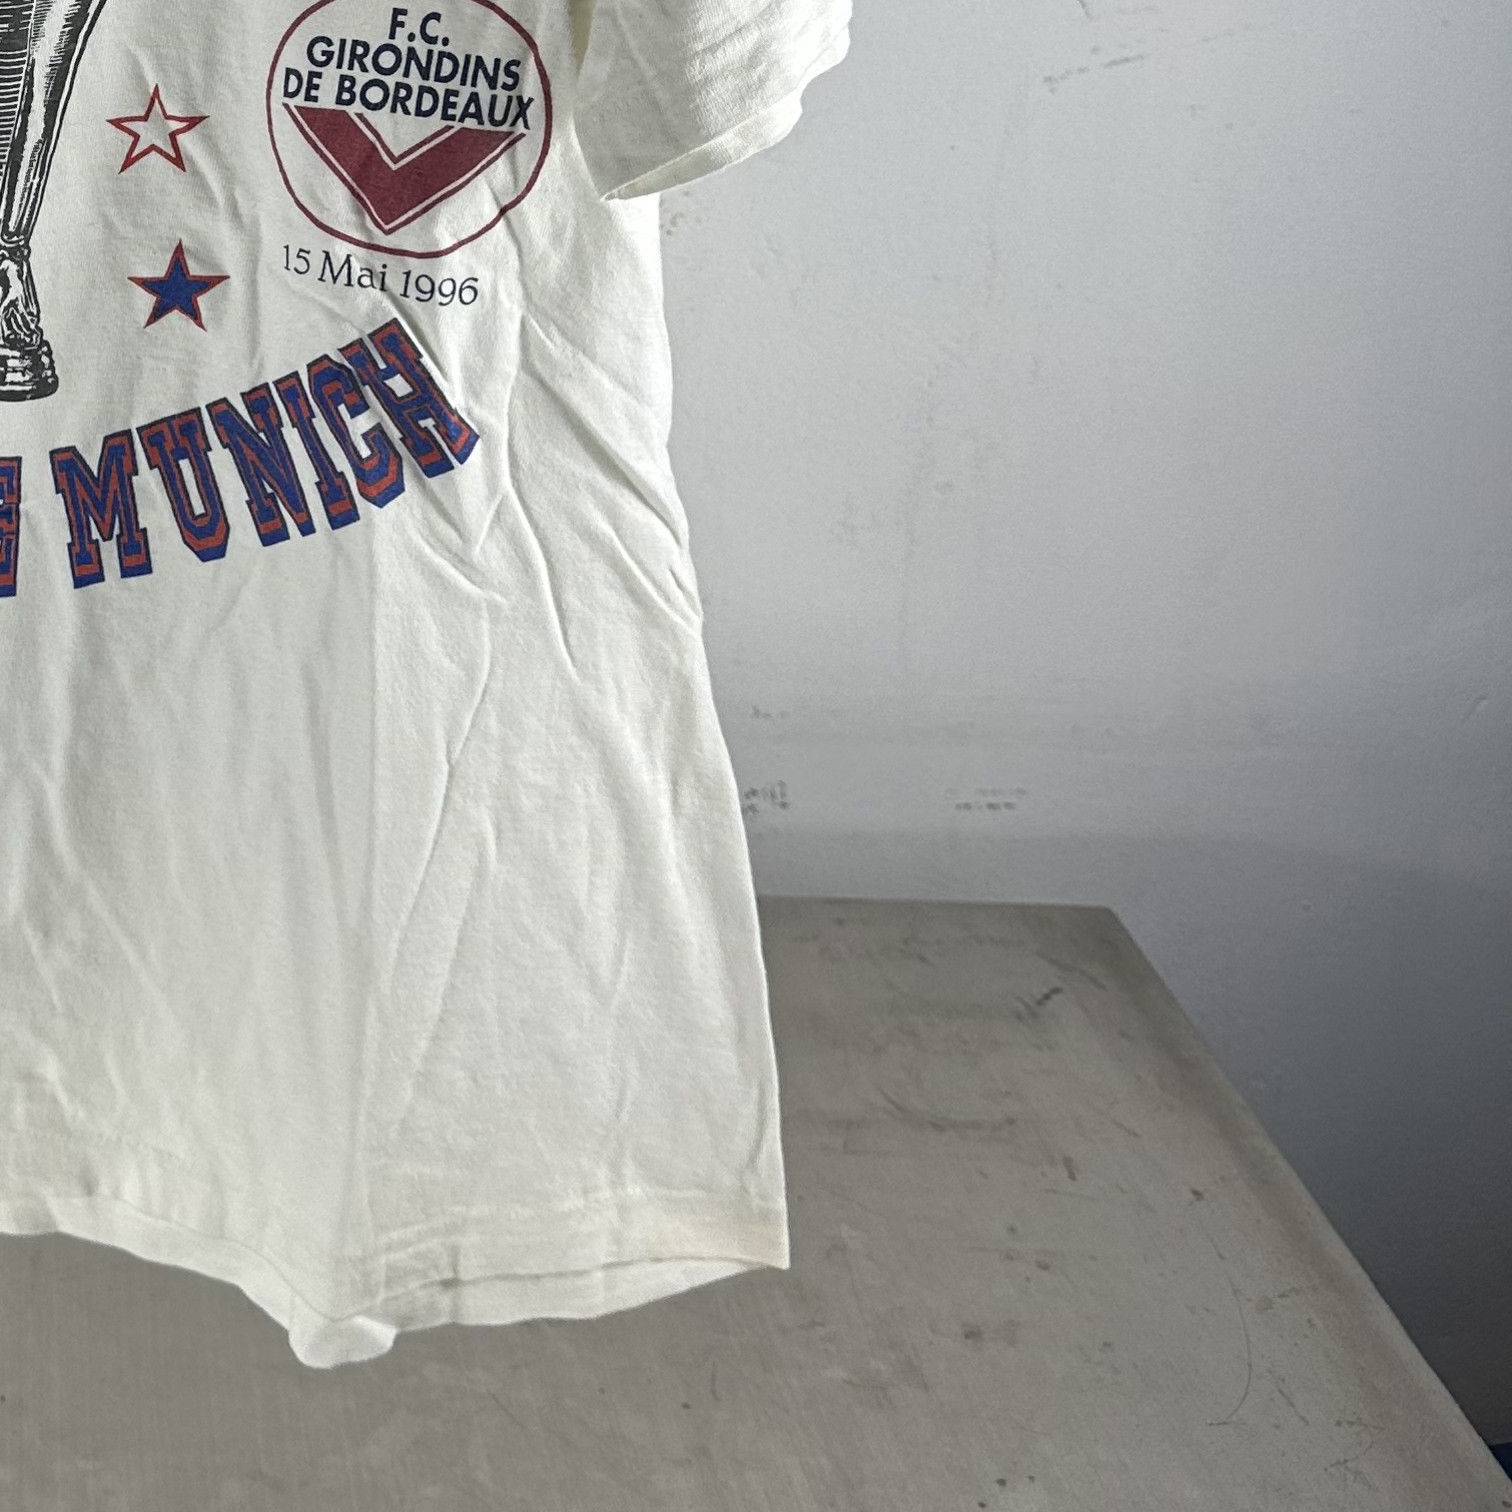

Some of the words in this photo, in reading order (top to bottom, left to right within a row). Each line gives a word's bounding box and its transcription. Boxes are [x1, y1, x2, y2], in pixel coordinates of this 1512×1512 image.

[388, 7, 449, 47] F.C.
[306, 35, 522, 92] GIRONDINS
[282, 66, 323, 103] DE
[334, 74, 535, 131] BORDEAUX
[282, 244, 311, 276] 15
[317, 250, 388, 292] Mai
[399, 269, 479, 307] 1996
[48, 317, 482, 591] MUNICH
